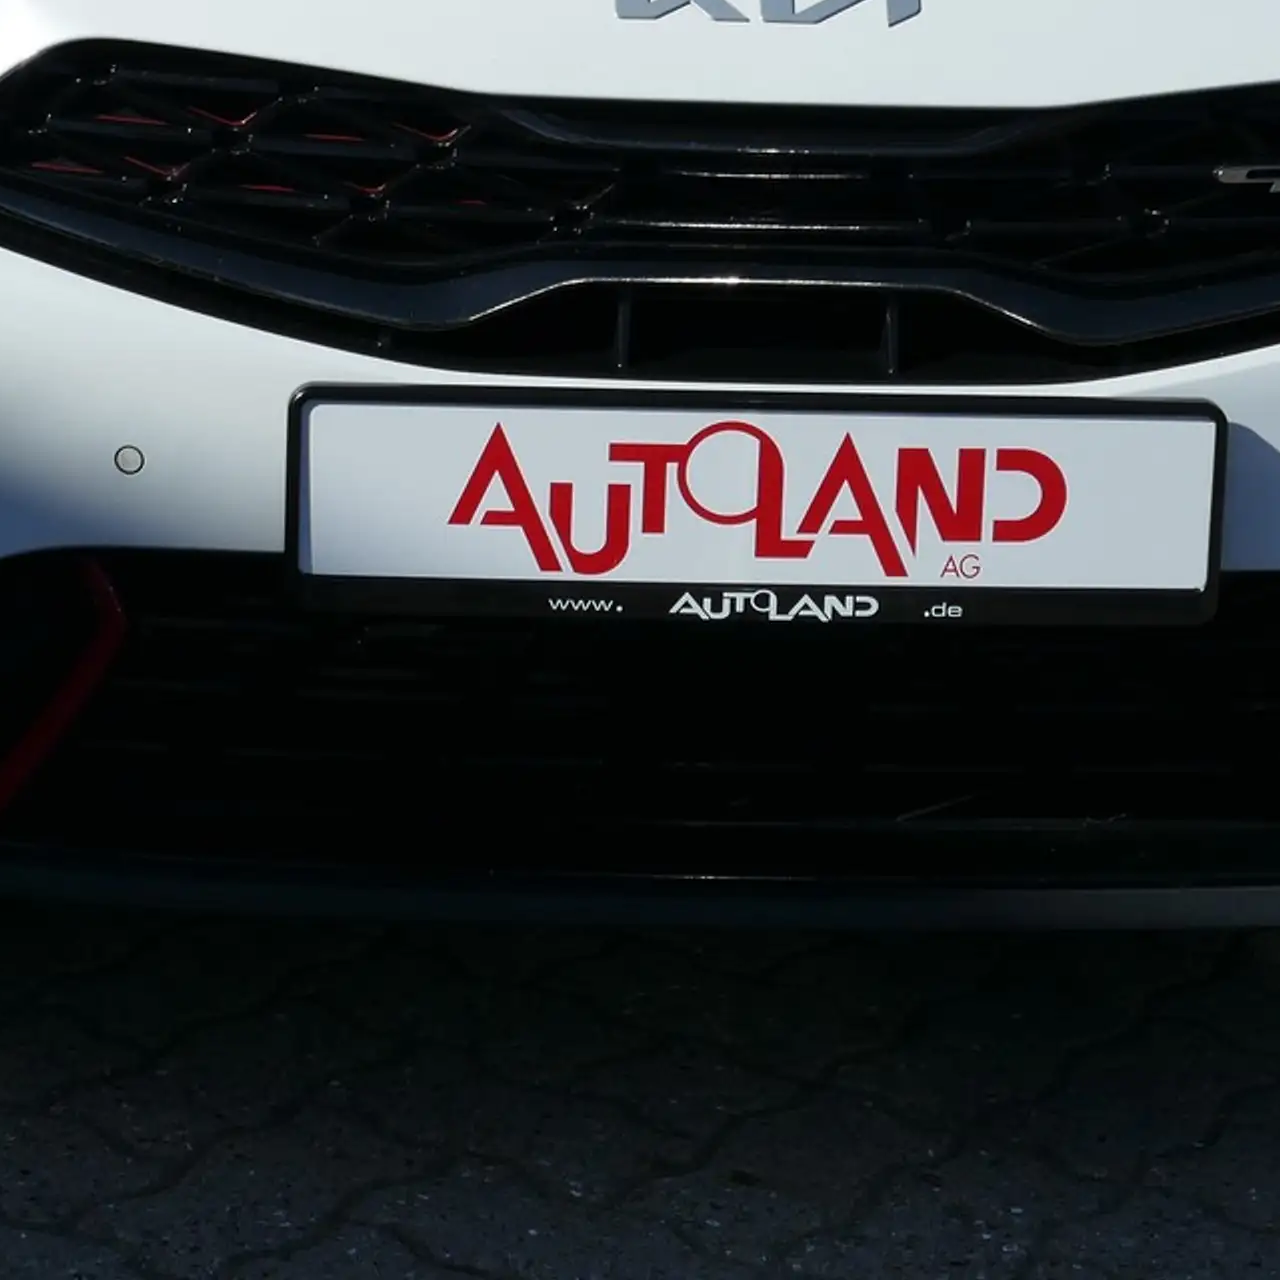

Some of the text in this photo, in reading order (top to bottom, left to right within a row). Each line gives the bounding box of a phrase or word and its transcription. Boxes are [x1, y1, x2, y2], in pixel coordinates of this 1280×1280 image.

[448, 421, 1067, 577] AUTOLAND
[940, 555, 981, 579] AG
[549, 589, 963, 622] www. AUTOLAND .de
